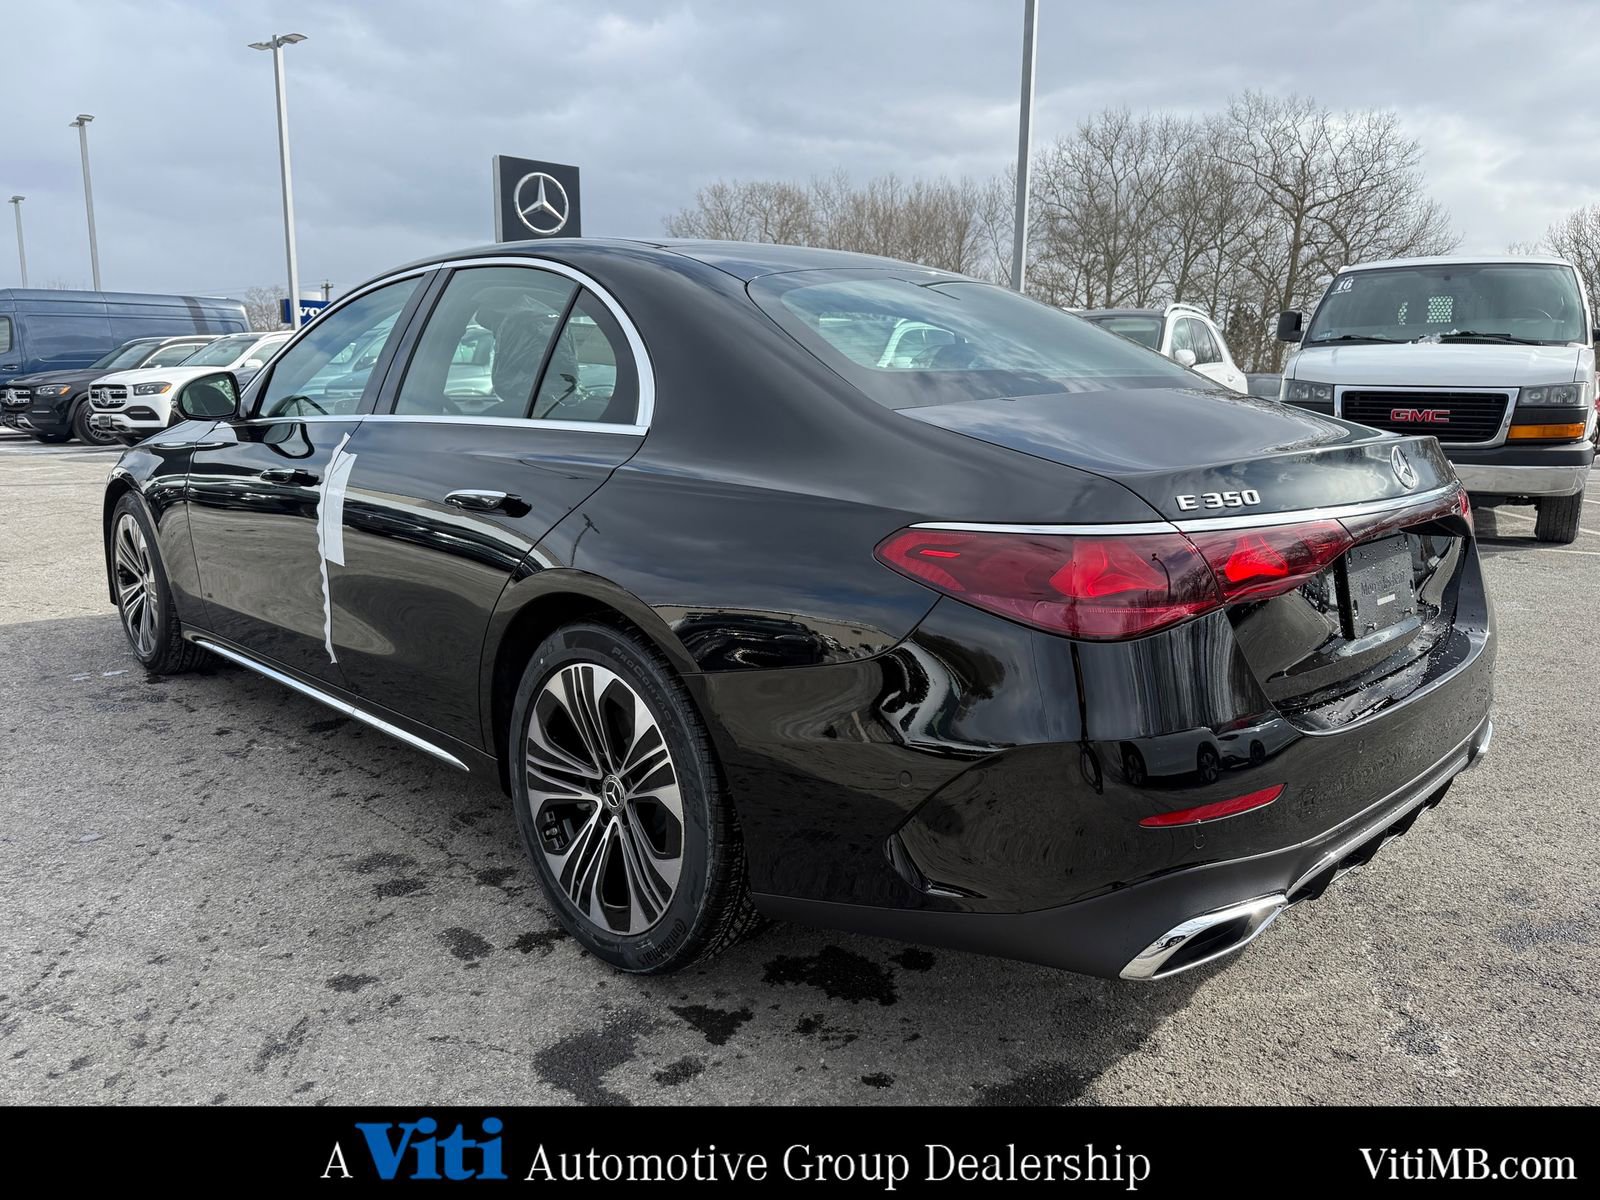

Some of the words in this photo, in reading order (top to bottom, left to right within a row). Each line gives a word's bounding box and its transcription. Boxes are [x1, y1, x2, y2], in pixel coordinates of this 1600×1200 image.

[299, 306, 323, 317] VO
[1390, 408, 1451, 423] GMC
[1175, 494, 1200, 511] E
[1201, 489, 1261, 509] 350
